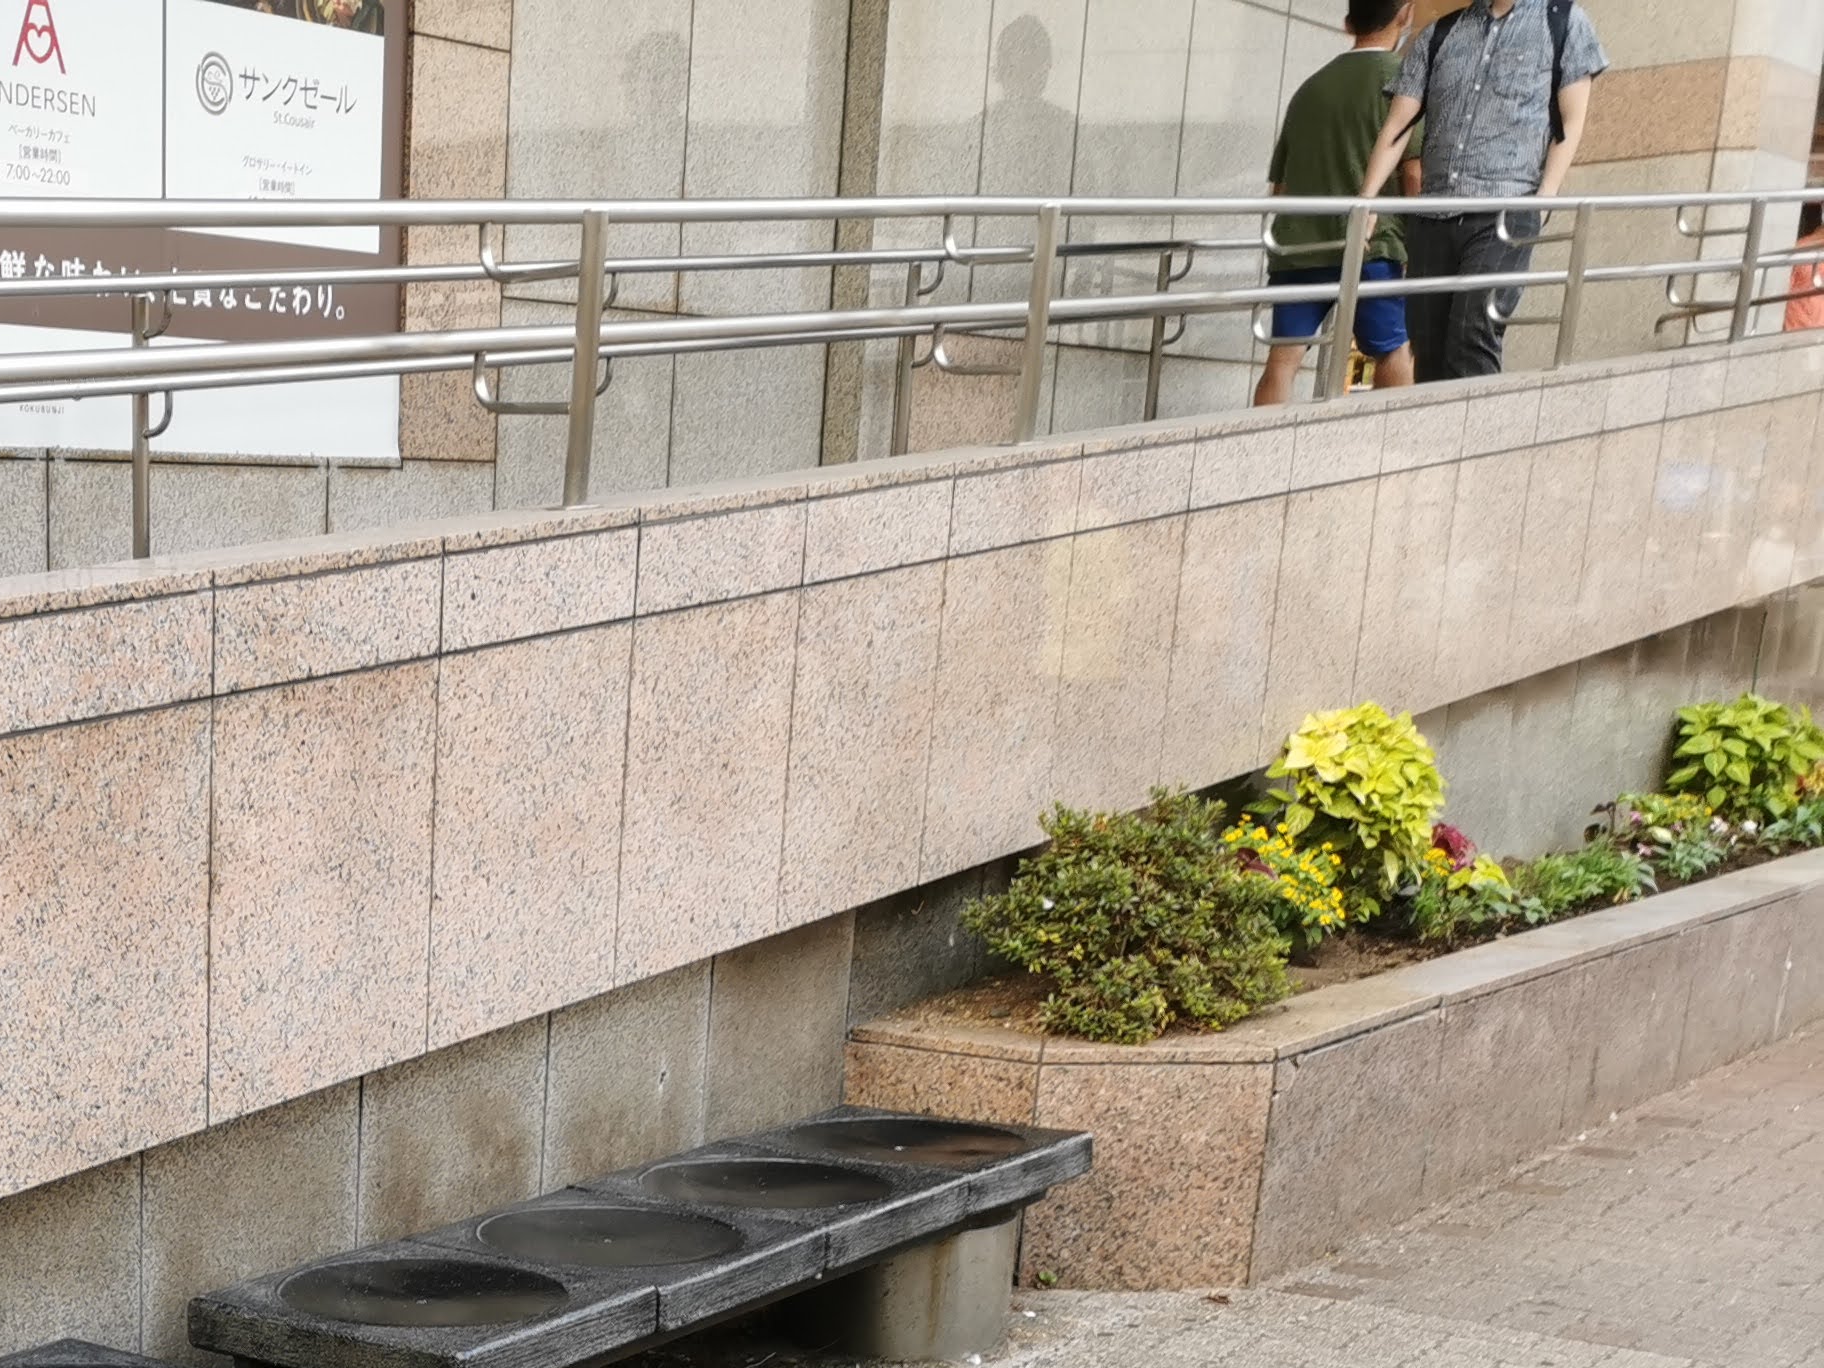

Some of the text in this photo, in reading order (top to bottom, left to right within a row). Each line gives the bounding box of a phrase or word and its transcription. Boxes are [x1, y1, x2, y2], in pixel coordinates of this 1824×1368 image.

[239, 66, 358, 114] サンクゼール
[7, 124, 72, 144] ベーカリーカフェ
